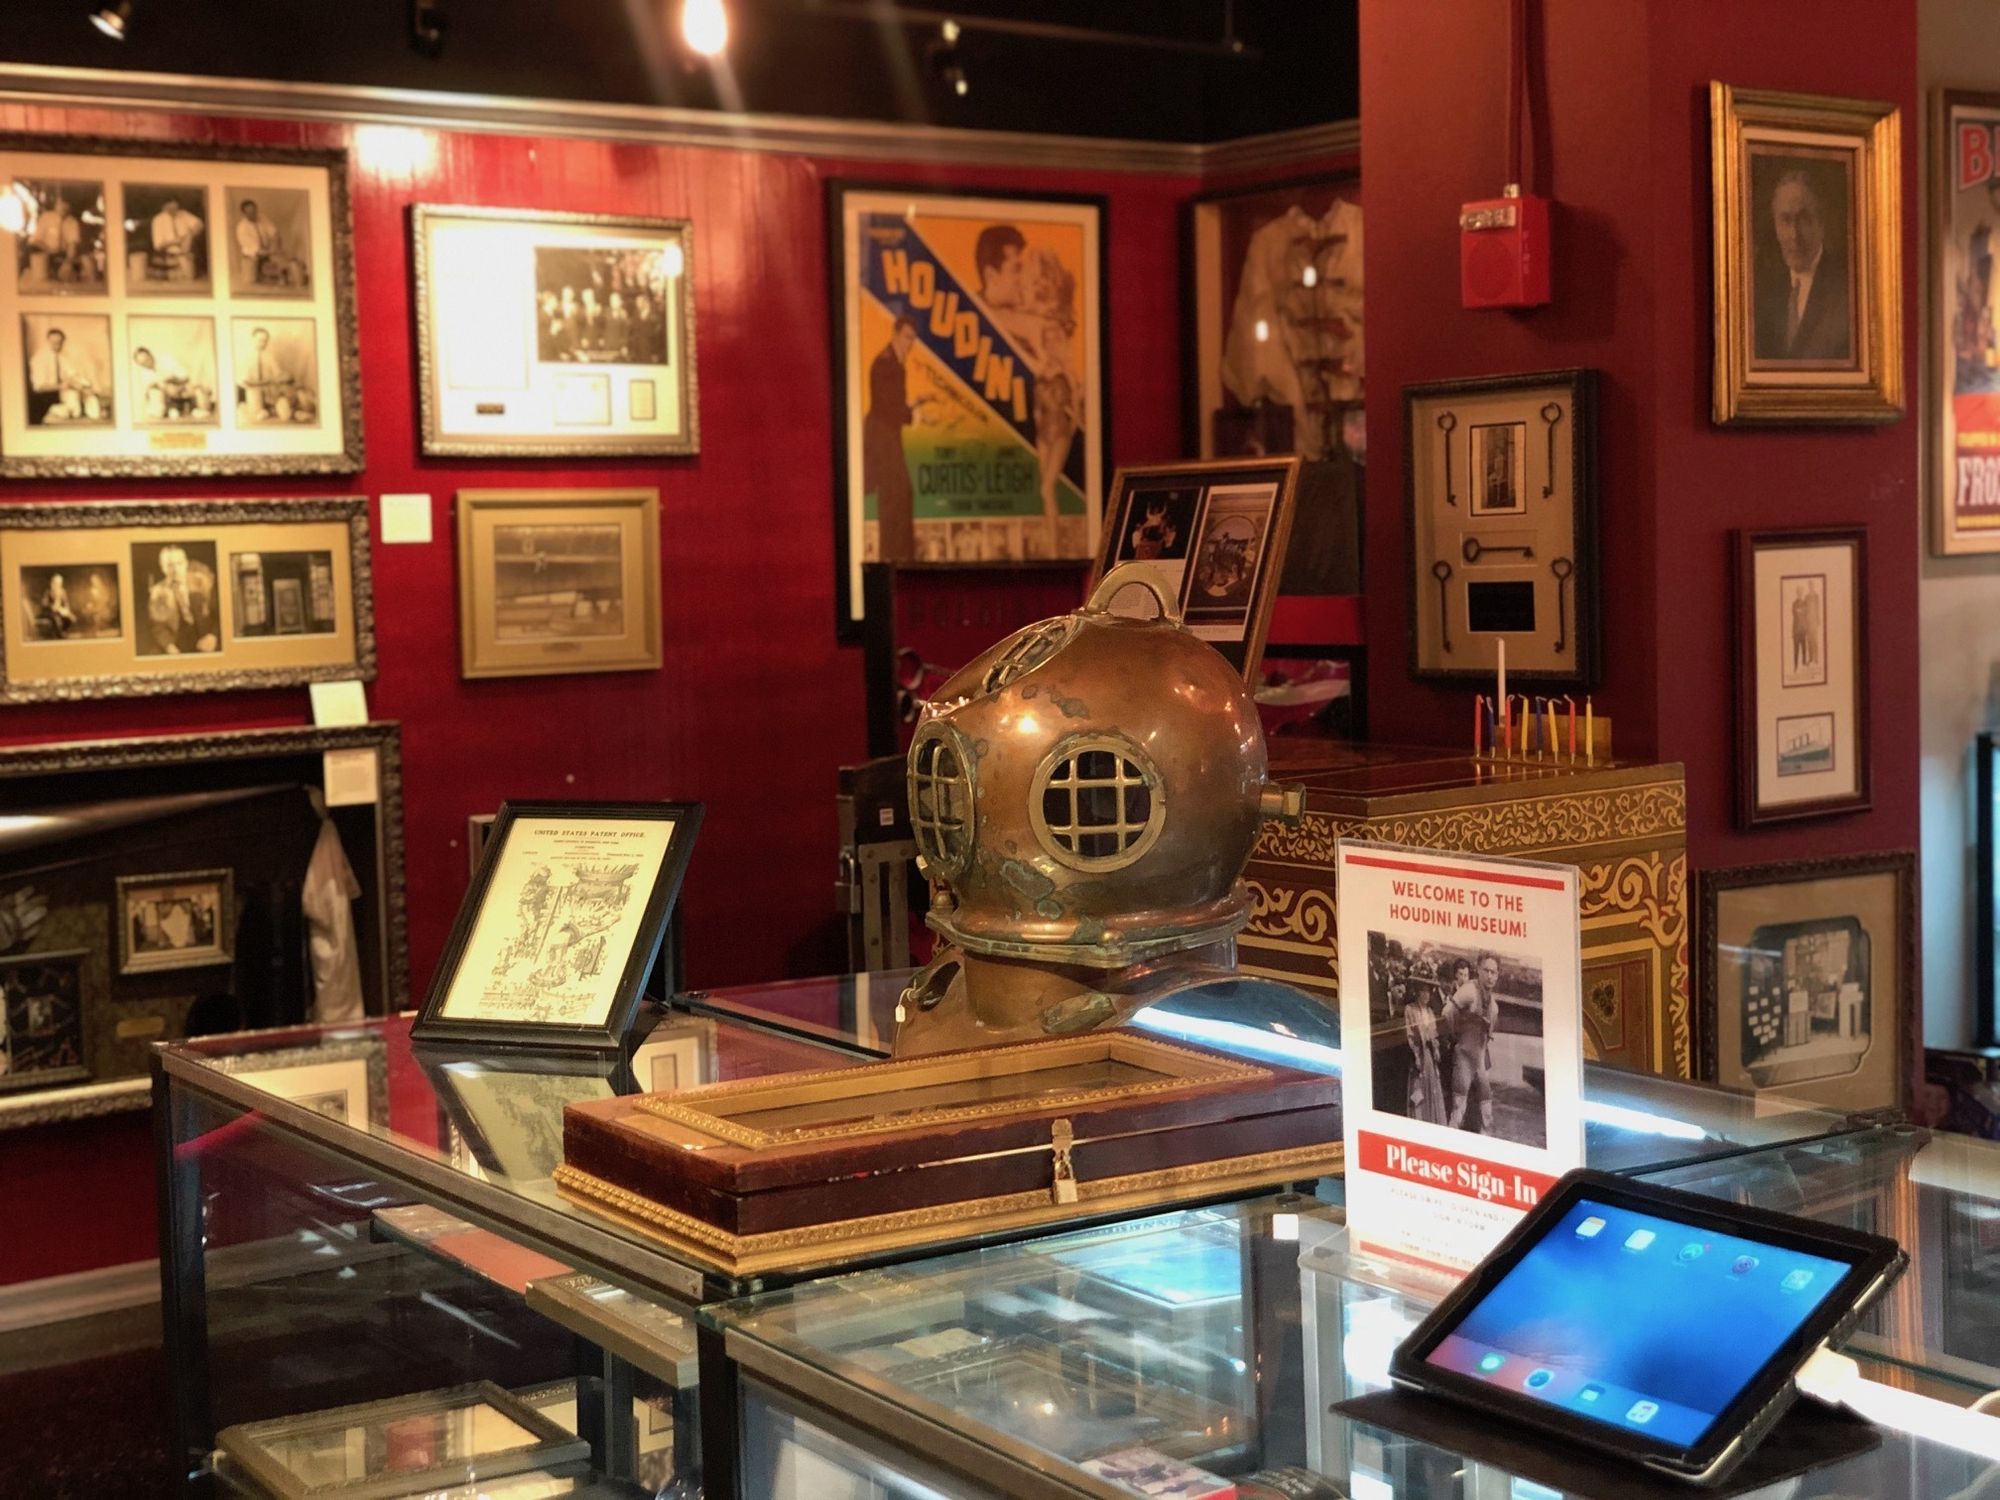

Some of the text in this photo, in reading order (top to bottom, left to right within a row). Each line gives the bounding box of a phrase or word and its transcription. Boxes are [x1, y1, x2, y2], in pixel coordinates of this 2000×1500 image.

[881, 248, 1028, 423] HOUDINI
[917, 461, 1034, 495] CURTIS LEIGH
[1957, 456, 2000, 506] FRO
[561, 829, 587, 837] STATES
[1392, 880, 1523, 912] WELCOME TO THE
[1390, 903, 1527, 938] HOUDINI MUSEUM!
[1386, 1144, 1538, 1205] Please Sign-In
